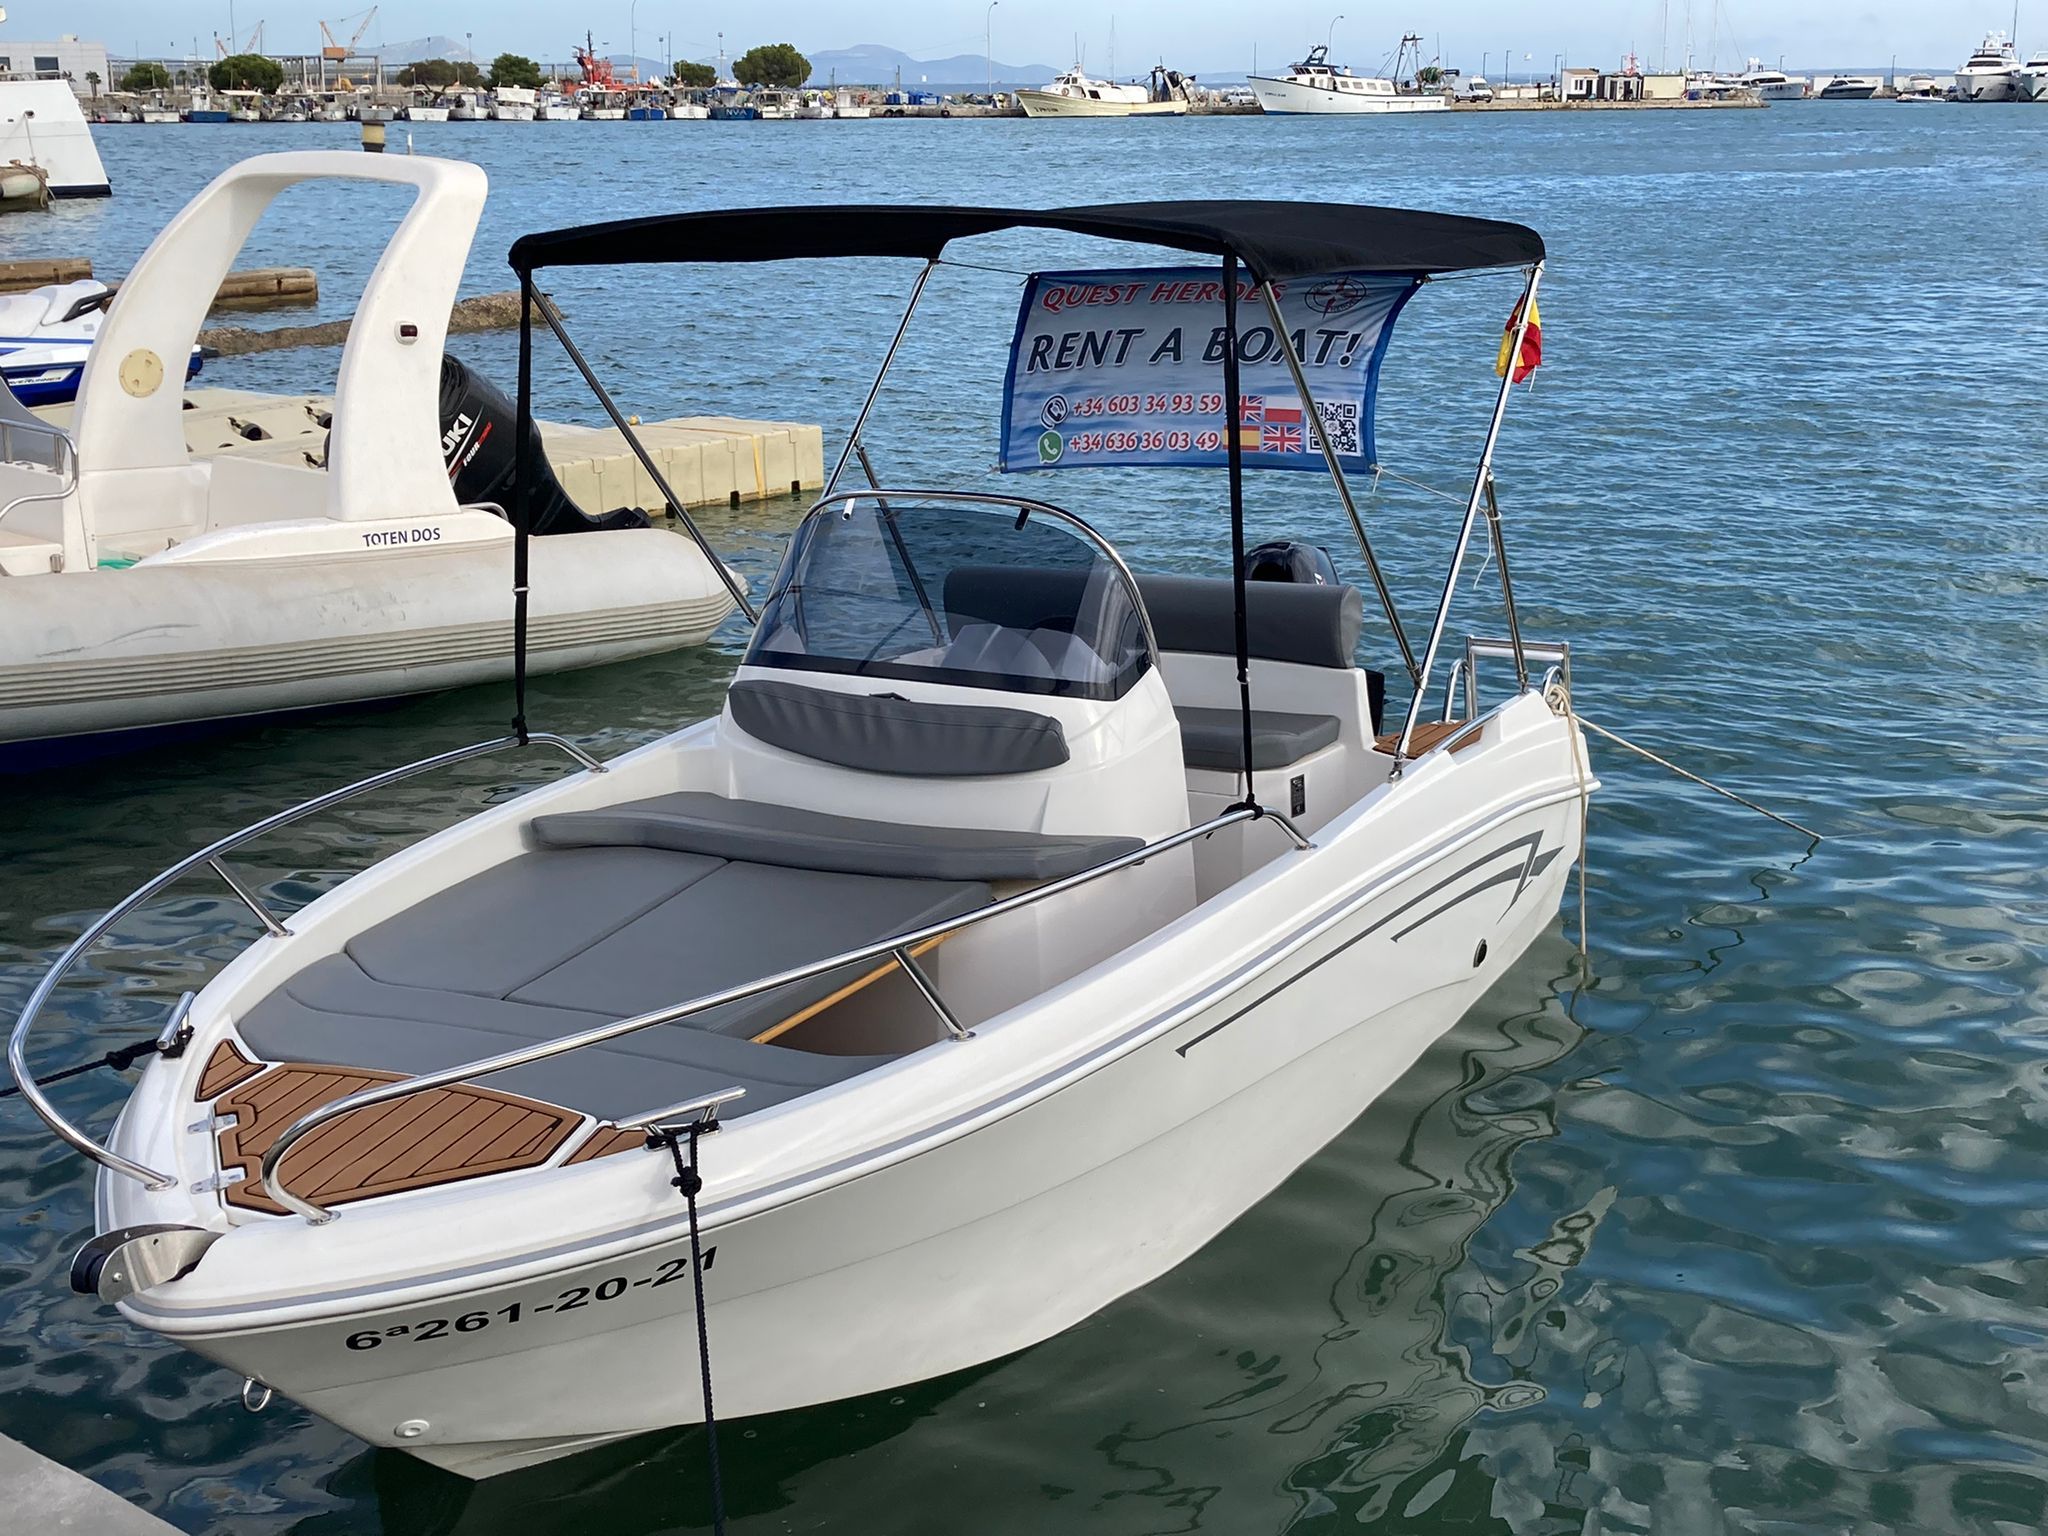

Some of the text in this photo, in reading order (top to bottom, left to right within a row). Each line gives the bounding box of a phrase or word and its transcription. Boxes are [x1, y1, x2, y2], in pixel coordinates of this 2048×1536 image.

[1042, 283, 1146, 313] QUEST
[1027, 326, 1362, 373] RENT A BOAT!
[1073, 393, 1223, 416] +34 603 34 93 59
[442, 412, 473, 457] UKI
[1069, 431, 1220, 452] +34 636 36 03 49
[362, 527, 441, 547] TOTEN DOS
